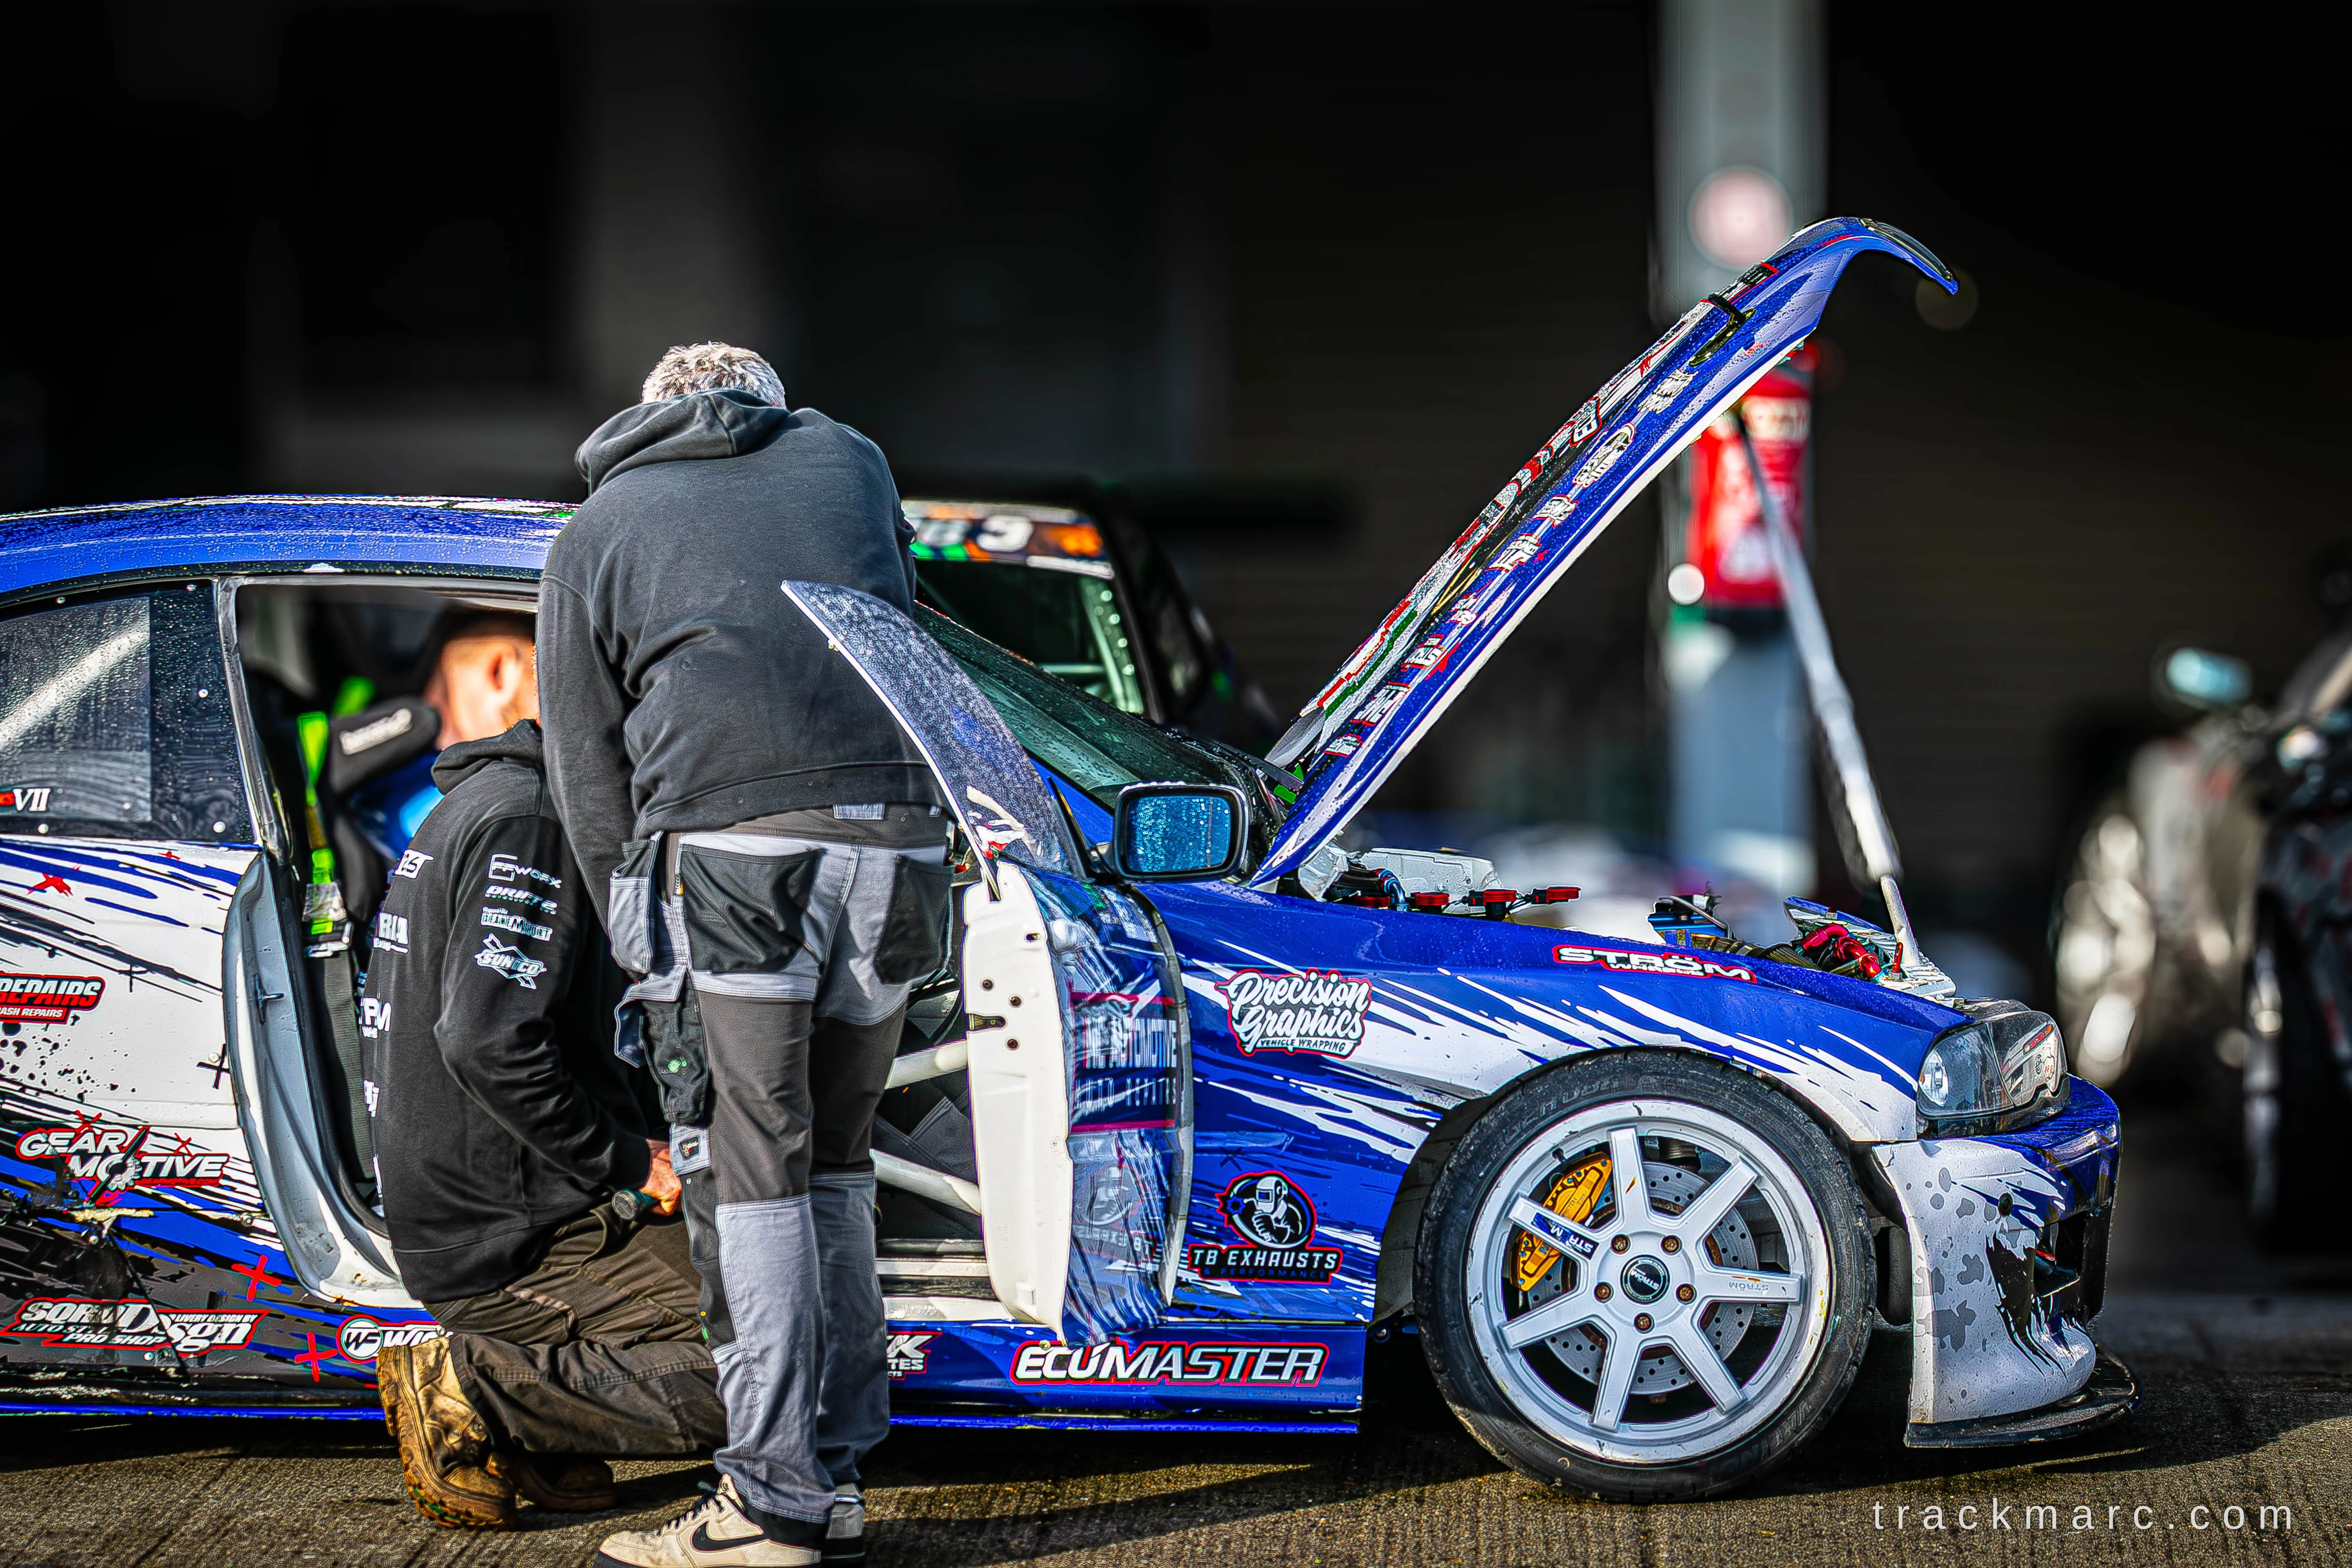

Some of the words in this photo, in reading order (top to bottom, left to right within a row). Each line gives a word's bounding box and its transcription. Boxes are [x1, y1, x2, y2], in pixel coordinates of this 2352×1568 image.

[481, 953, 541, 975] SUNOCO
[1559, 947, 1751, 980] STRÖM
[1217, 971, 1370, 1020] Precision
[21, 1008, 64, 1018] REPAIRS
[1233, 1005, 1362, 1052] Graphics
[1261, 1039, 1294, 1047] VEHICLE
[1299, 1039, 1346, 1051] WRAPPING
[19, 1131, 127, 1155] GEAR
[69, 1154, 227, 1188] MOTIVE
[1193, 1249, 1218, 1265] TB
[1227, 1250, 1338, 1269] EXHAUSTS
[1220, 1269, 1326, 1279] PERFORMANCE
[1631, 1269, 1660, 1290] STRÖM
[1728, 1282, 1769, 1292] STRÖM
[13, 1323, 65, 1332] AUTO
[62, 1333, 108, 1344] PRO
[109, 1335, 167, 1346] SHOP
[1018, 1345, 1323, 1380] ECUMASTER
